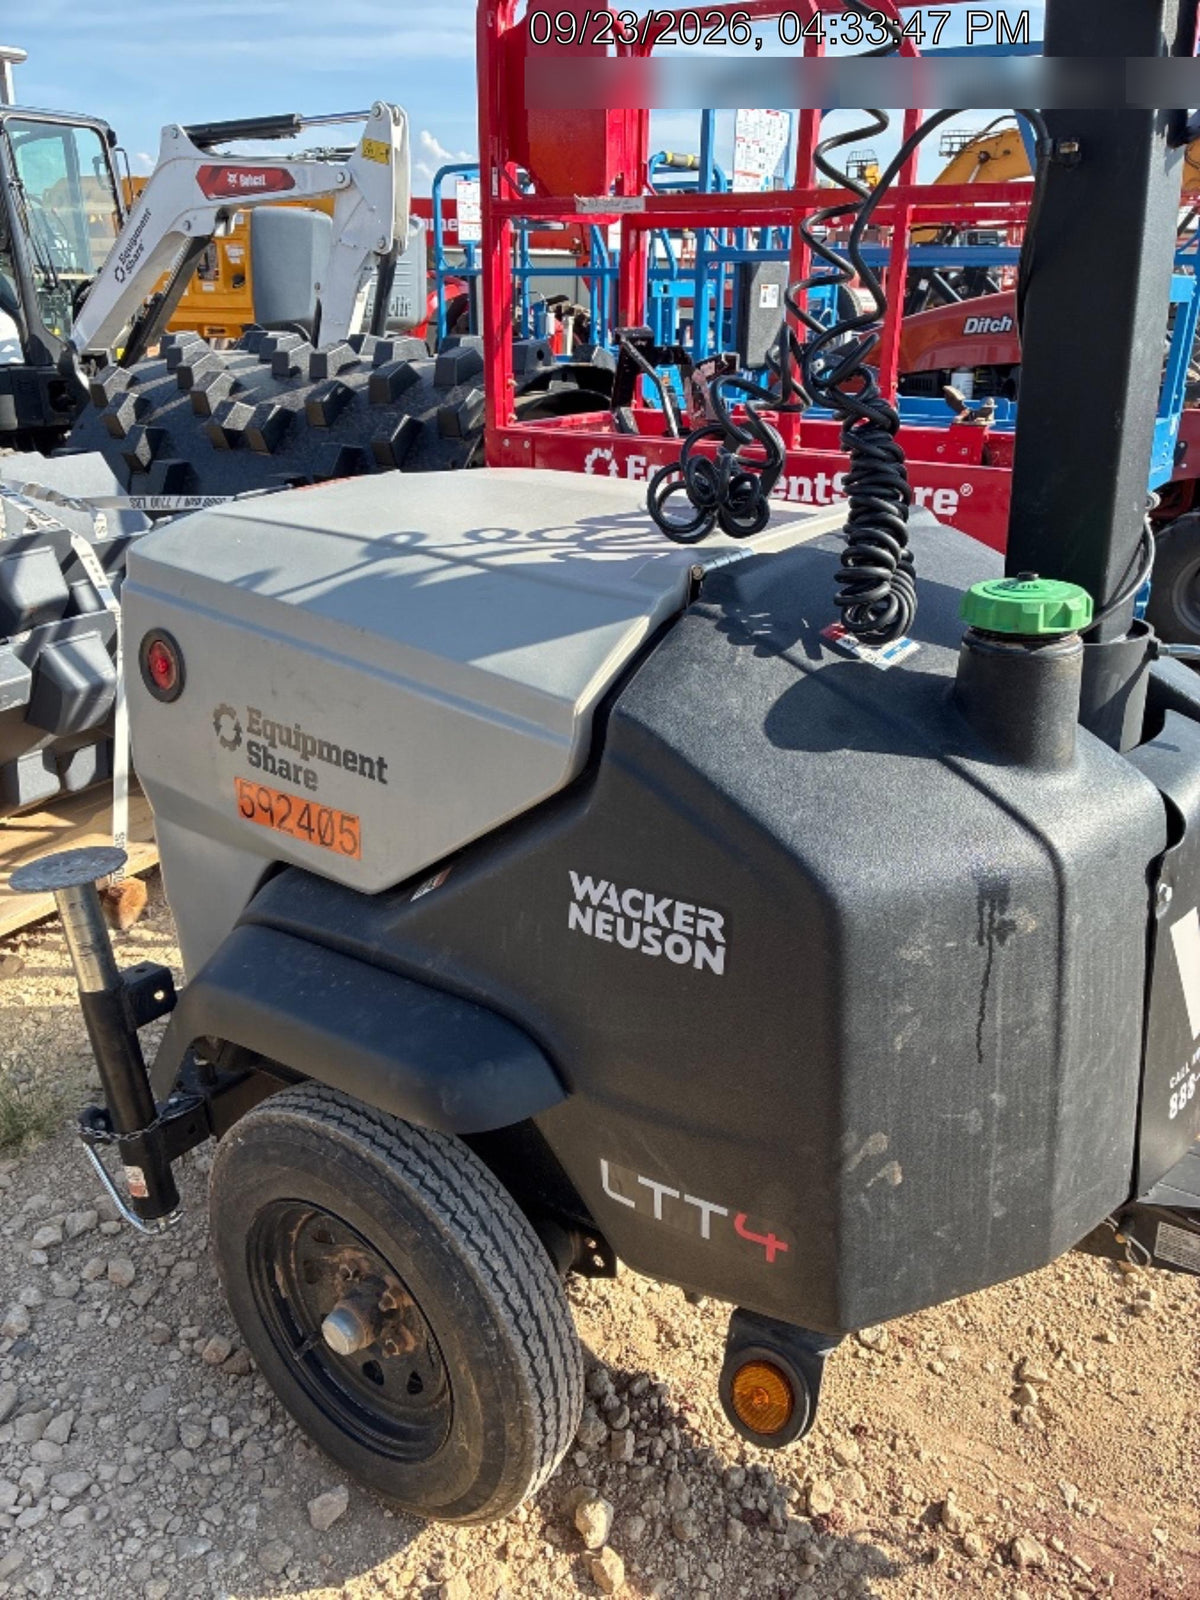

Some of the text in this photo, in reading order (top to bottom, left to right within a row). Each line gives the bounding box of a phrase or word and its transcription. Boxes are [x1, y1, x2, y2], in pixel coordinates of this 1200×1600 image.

[963, 316, 1013, 334] Ditch
[627, 455, 960, 517] EqentSre
[246, 705, 388, 785] Equipment
[246, 741, 318, 791] Share
[239, 781, 360, 855] 592405
[568, 870, 726, 943] WACKER
[568, 901, 726, 976] NEUSON
[600, 1158, 788, 1263] LTT4
